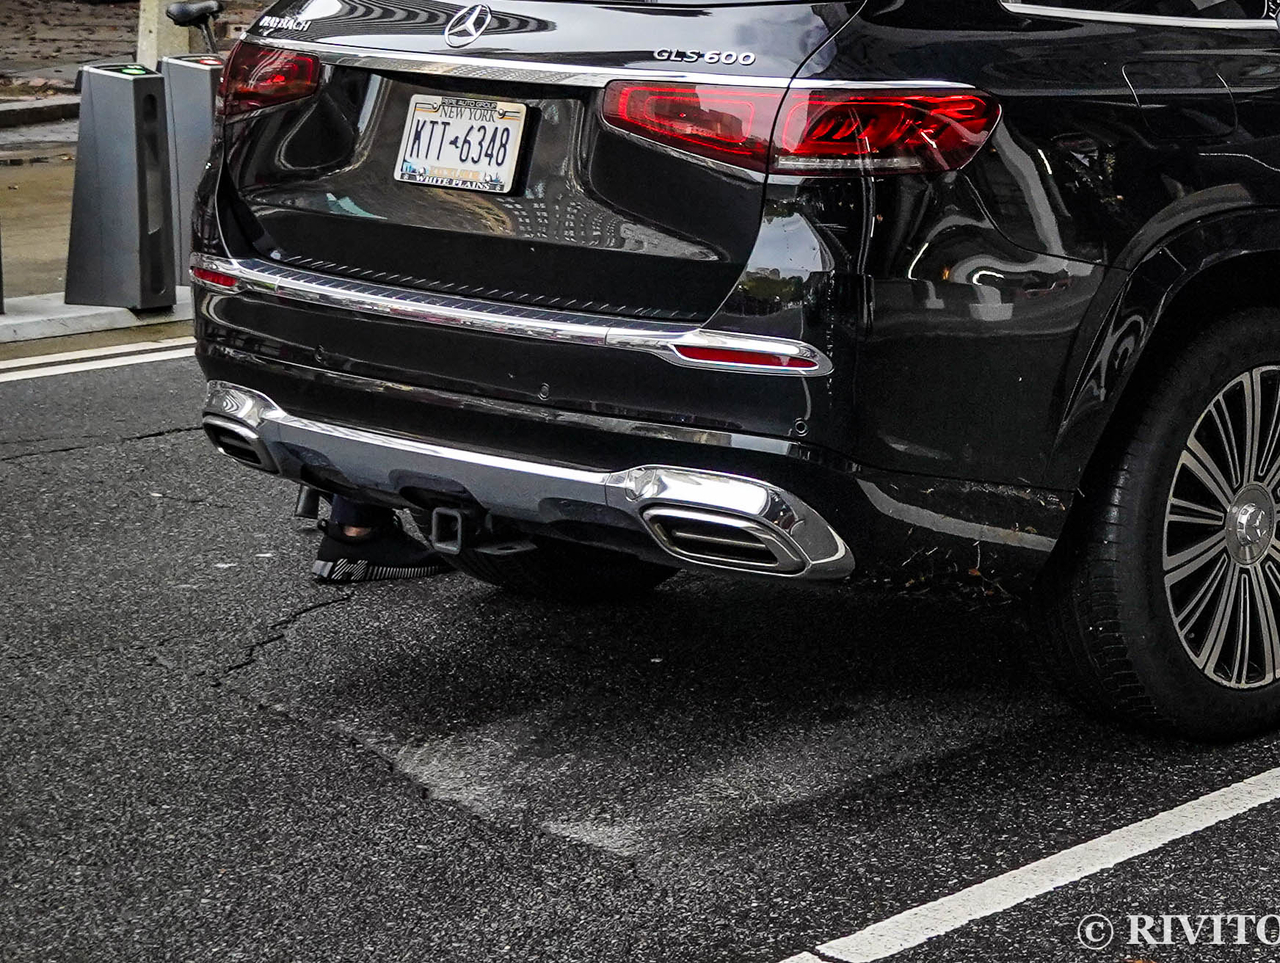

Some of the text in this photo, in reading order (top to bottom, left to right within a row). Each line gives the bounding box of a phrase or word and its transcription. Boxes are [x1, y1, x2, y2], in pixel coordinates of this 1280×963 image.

[653, 47, 756, 66] GLS 600
[440, 105, 496, 123] NEW YORK
[409, 119, 512, 168] KTT 6348
[415, 174, 491, 190] WHITE PLAINS
